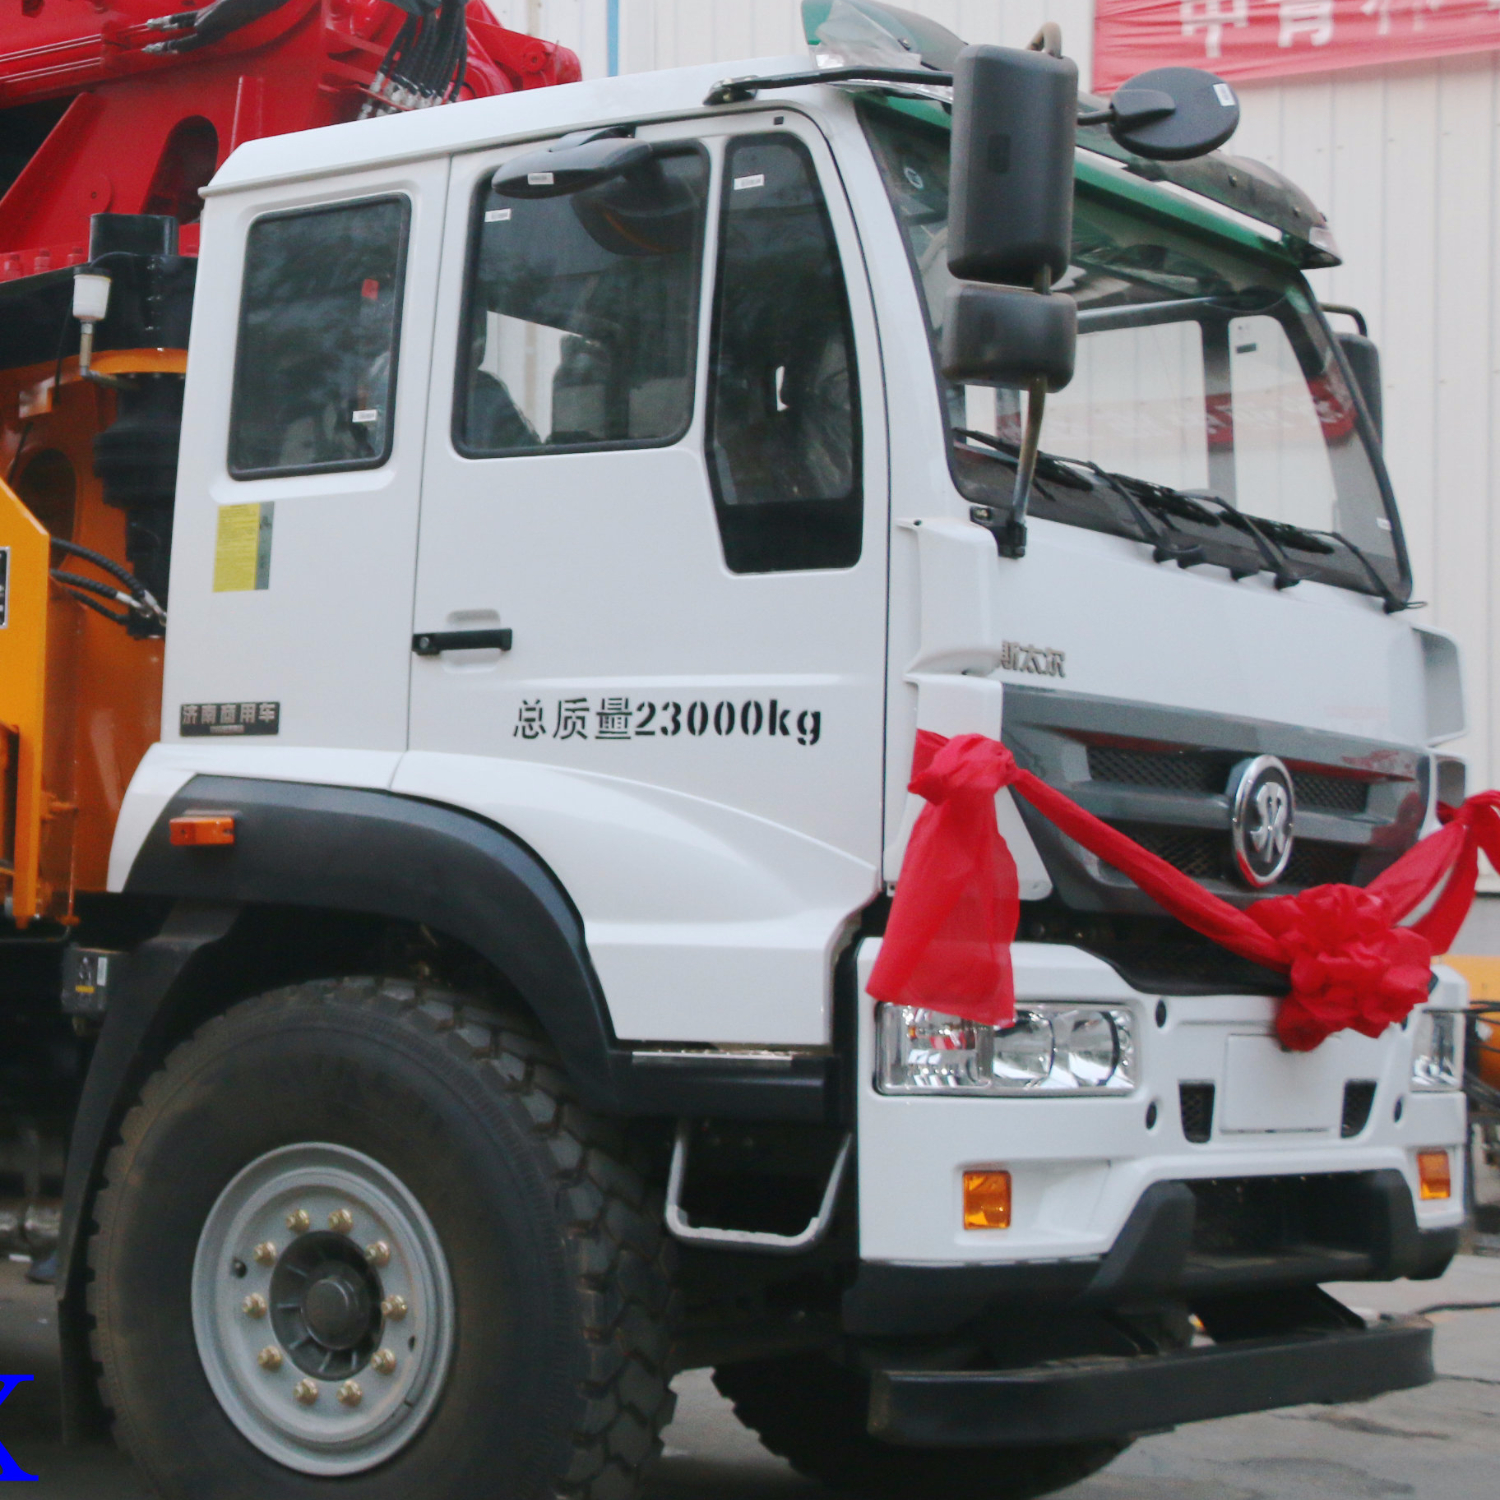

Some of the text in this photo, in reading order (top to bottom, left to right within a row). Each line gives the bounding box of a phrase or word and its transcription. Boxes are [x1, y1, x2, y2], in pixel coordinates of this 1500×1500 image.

[181, 702, 276, 725] 济南商用车
[513, 697, 821, 746] 总质量23000kg
